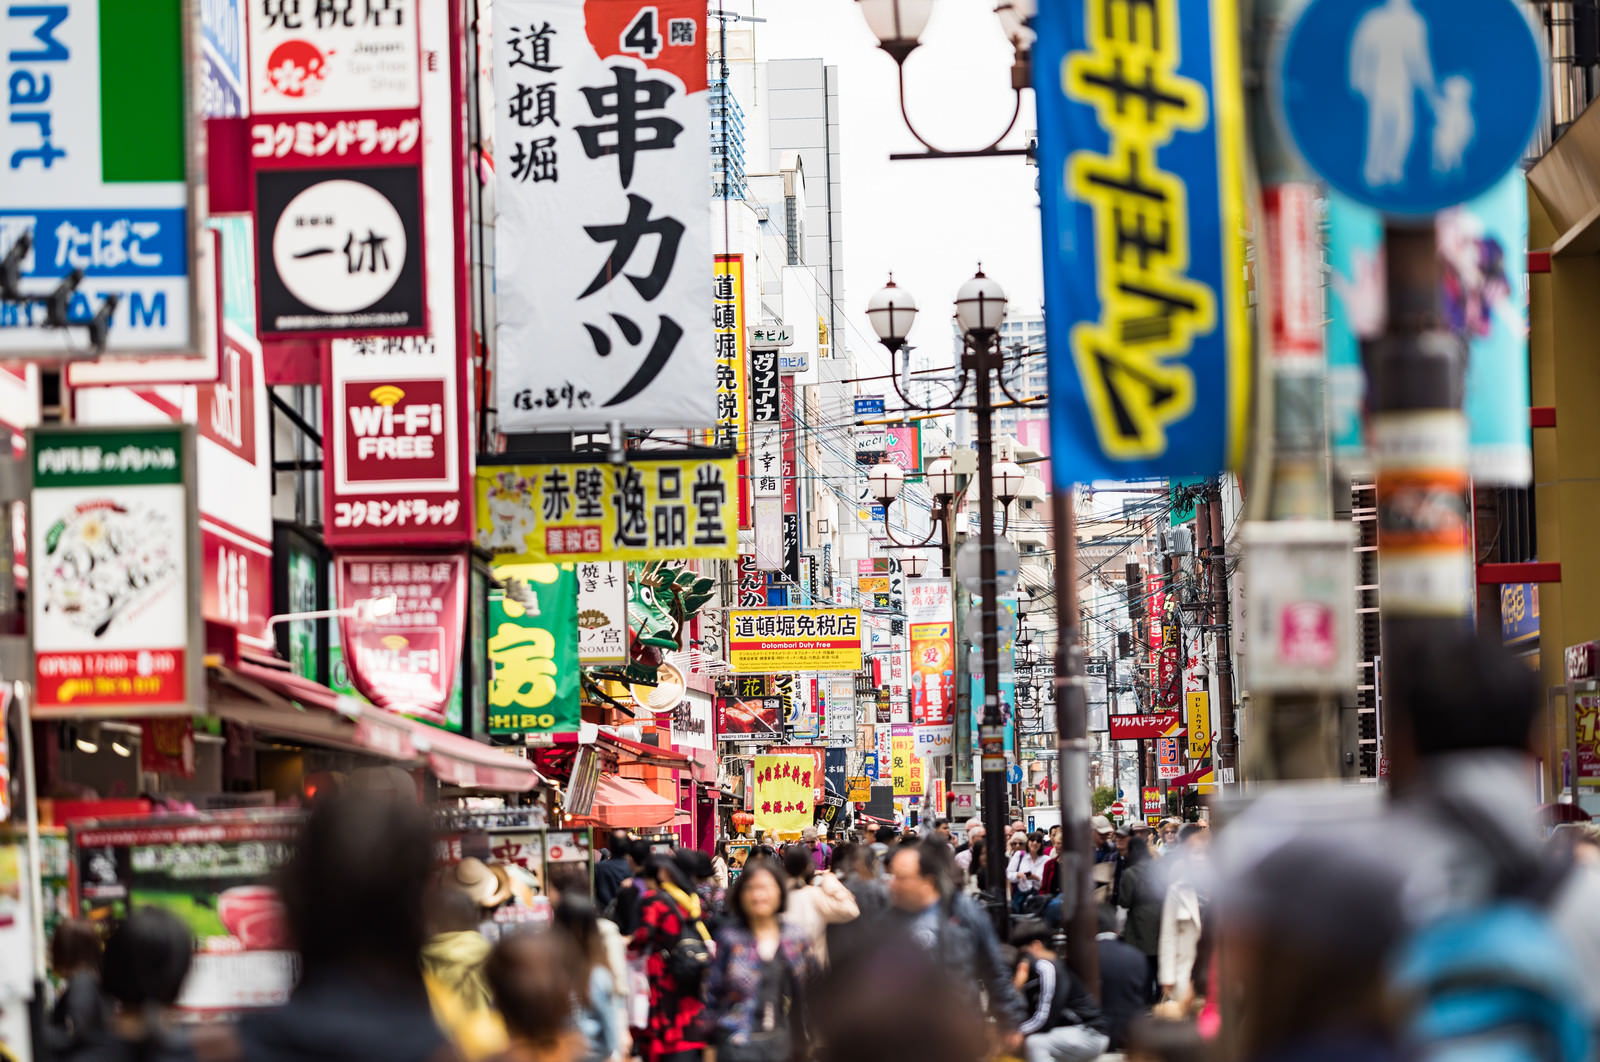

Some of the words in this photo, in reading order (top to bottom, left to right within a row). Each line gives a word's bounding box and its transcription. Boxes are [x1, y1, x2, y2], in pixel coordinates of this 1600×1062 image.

[7, 4, 70, 170] Mart
[506, 21, 563, 184] 道頓堀
[251, 118, 421, 159] コクミンドラッグ
[54, 219, 163, 269] たばこ
[291, 230, 391, 275] 一休
[572, 65, 686, 408] 串カツ
[753, 352, 776, 421] ダイアナ
[350, 404, 442, 436] Wi-Fi
[357, 435, 435, 460] FREE
[334, 499, 460, 528] コクミンドラッグ
[789, 515, 798, 546] スナック
[735, 614, 857, 638] 道頓堀免税店
[799, 641, 815, 650] Duty
[1112, 715, 1175, 727] ツルハドラッグ
[919, 733, 951, 747] EDION
